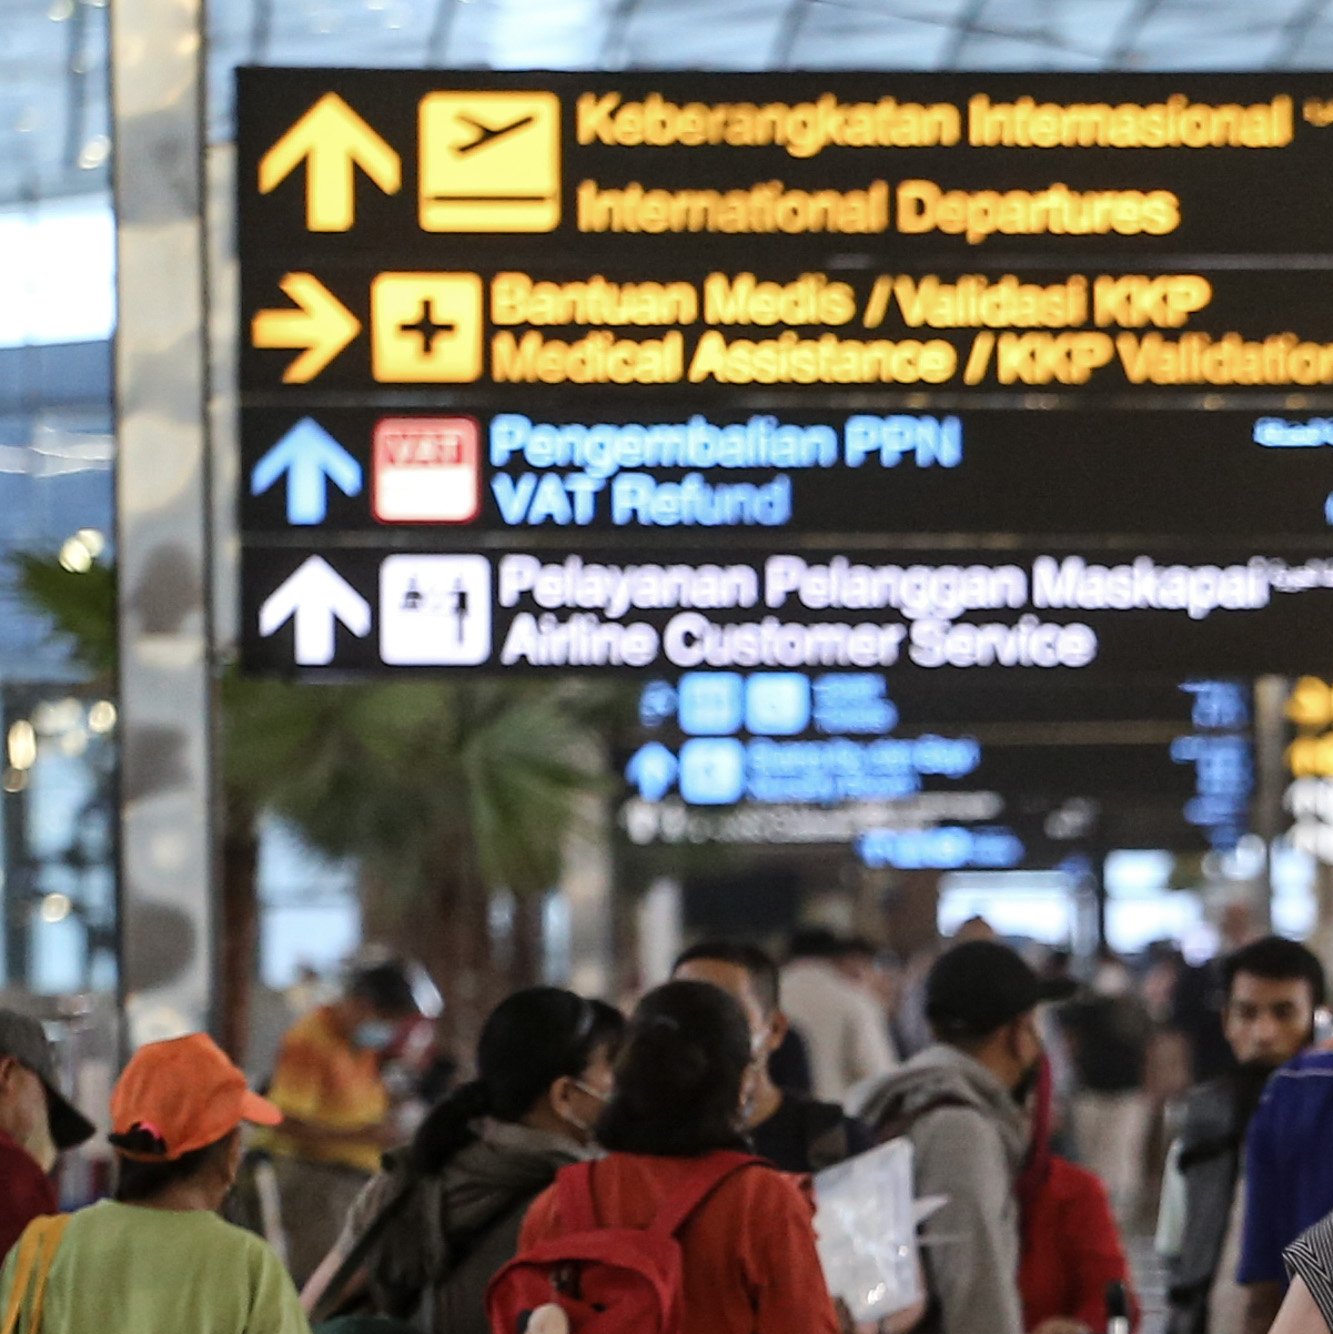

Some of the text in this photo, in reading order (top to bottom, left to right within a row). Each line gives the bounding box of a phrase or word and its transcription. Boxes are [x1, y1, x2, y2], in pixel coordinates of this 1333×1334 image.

[577, 93, 960, 158] Keberangkatan
[969, 93, 1293, 148] Internasional
[577, 179, 1181, 245] International Departures
[491, 271, 697, 326] Bantuan
[703, 272, 855, 326] Medis
[1094, 274, 1213, 328] KKP
[491, 331, 685, 383] Medical
[688, 330, 957, 384] Assistance
[998, 330, 1115, 385] KKP
[489, 414, 963, 477] Pengembalian PPN
[491, 473, 793, 526] VAT Refund
[499, 553, 758, 617] Pelayanan
[764, 554, 1029, 619] Pelanggan
[1031, 555, 1270, 620] Maskapai
[500, 612, 1098, 668] Airline Customer Service
